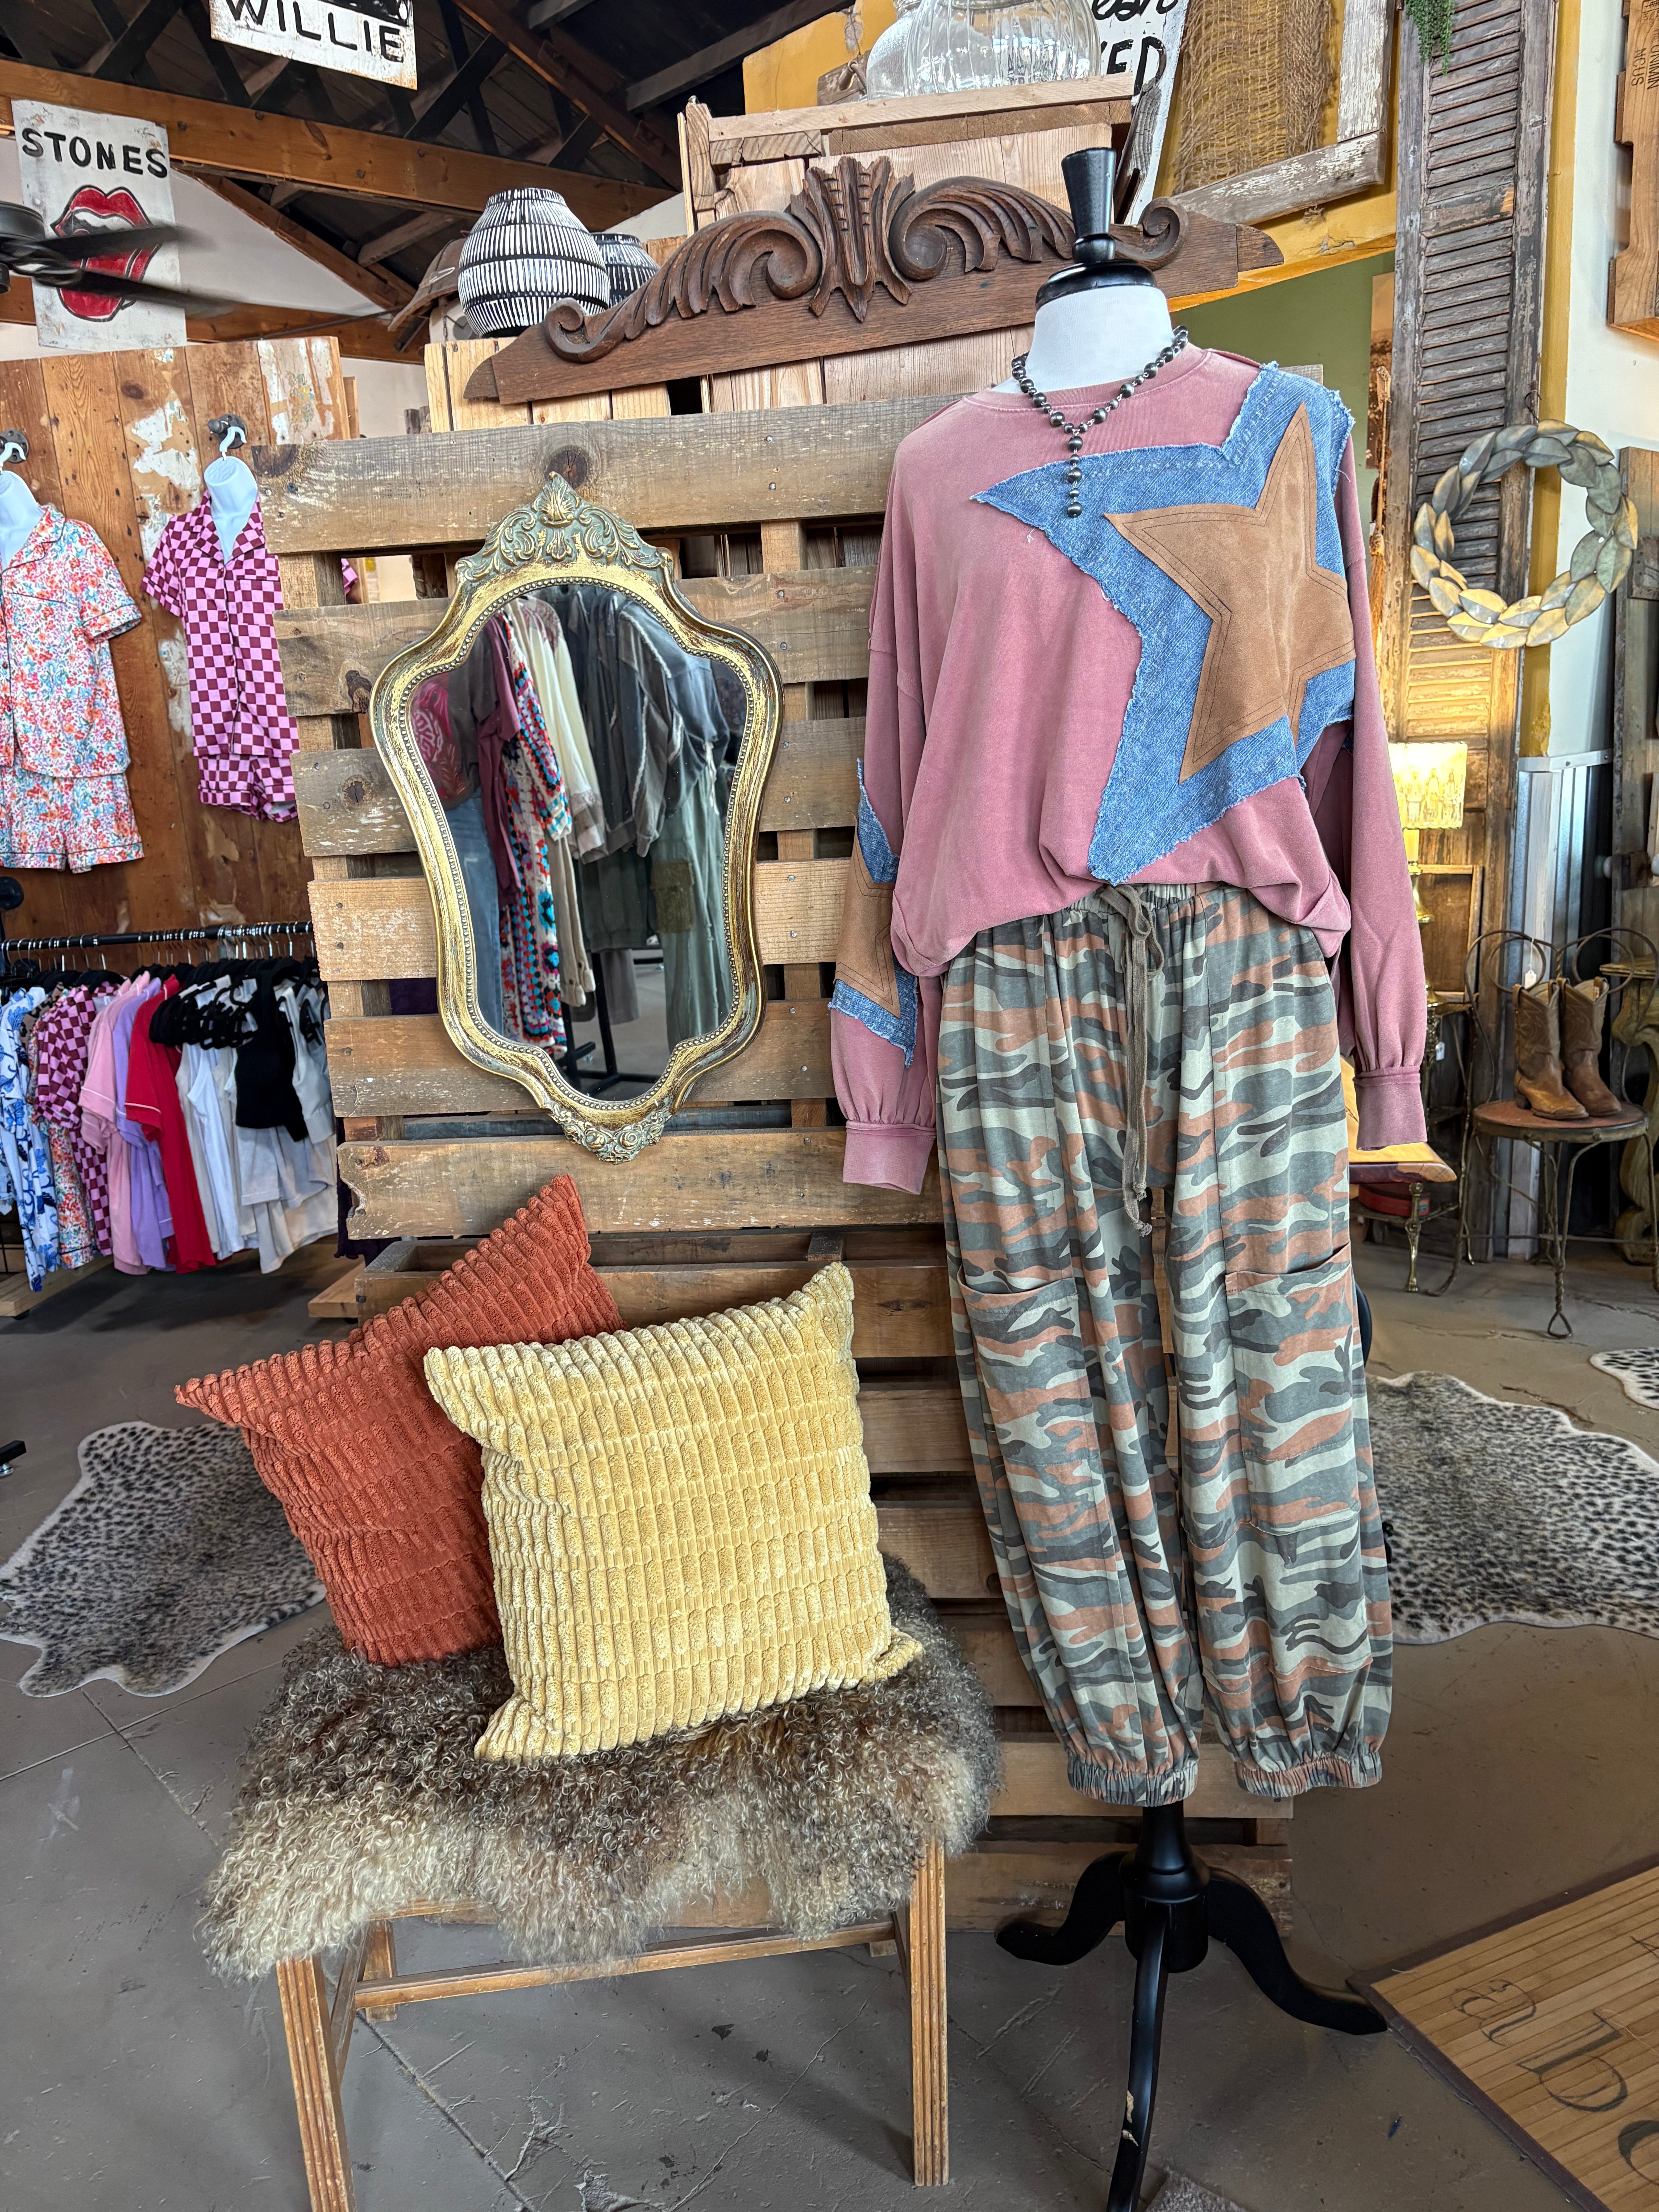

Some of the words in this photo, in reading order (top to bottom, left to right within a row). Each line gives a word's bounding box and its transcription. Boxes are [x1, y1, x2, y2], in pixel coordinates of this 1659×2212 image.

[225, 0, 404, 63] WILLIE
[1101, 36, 1167, 97] ED
[22, 127, 167, 178] STONES
